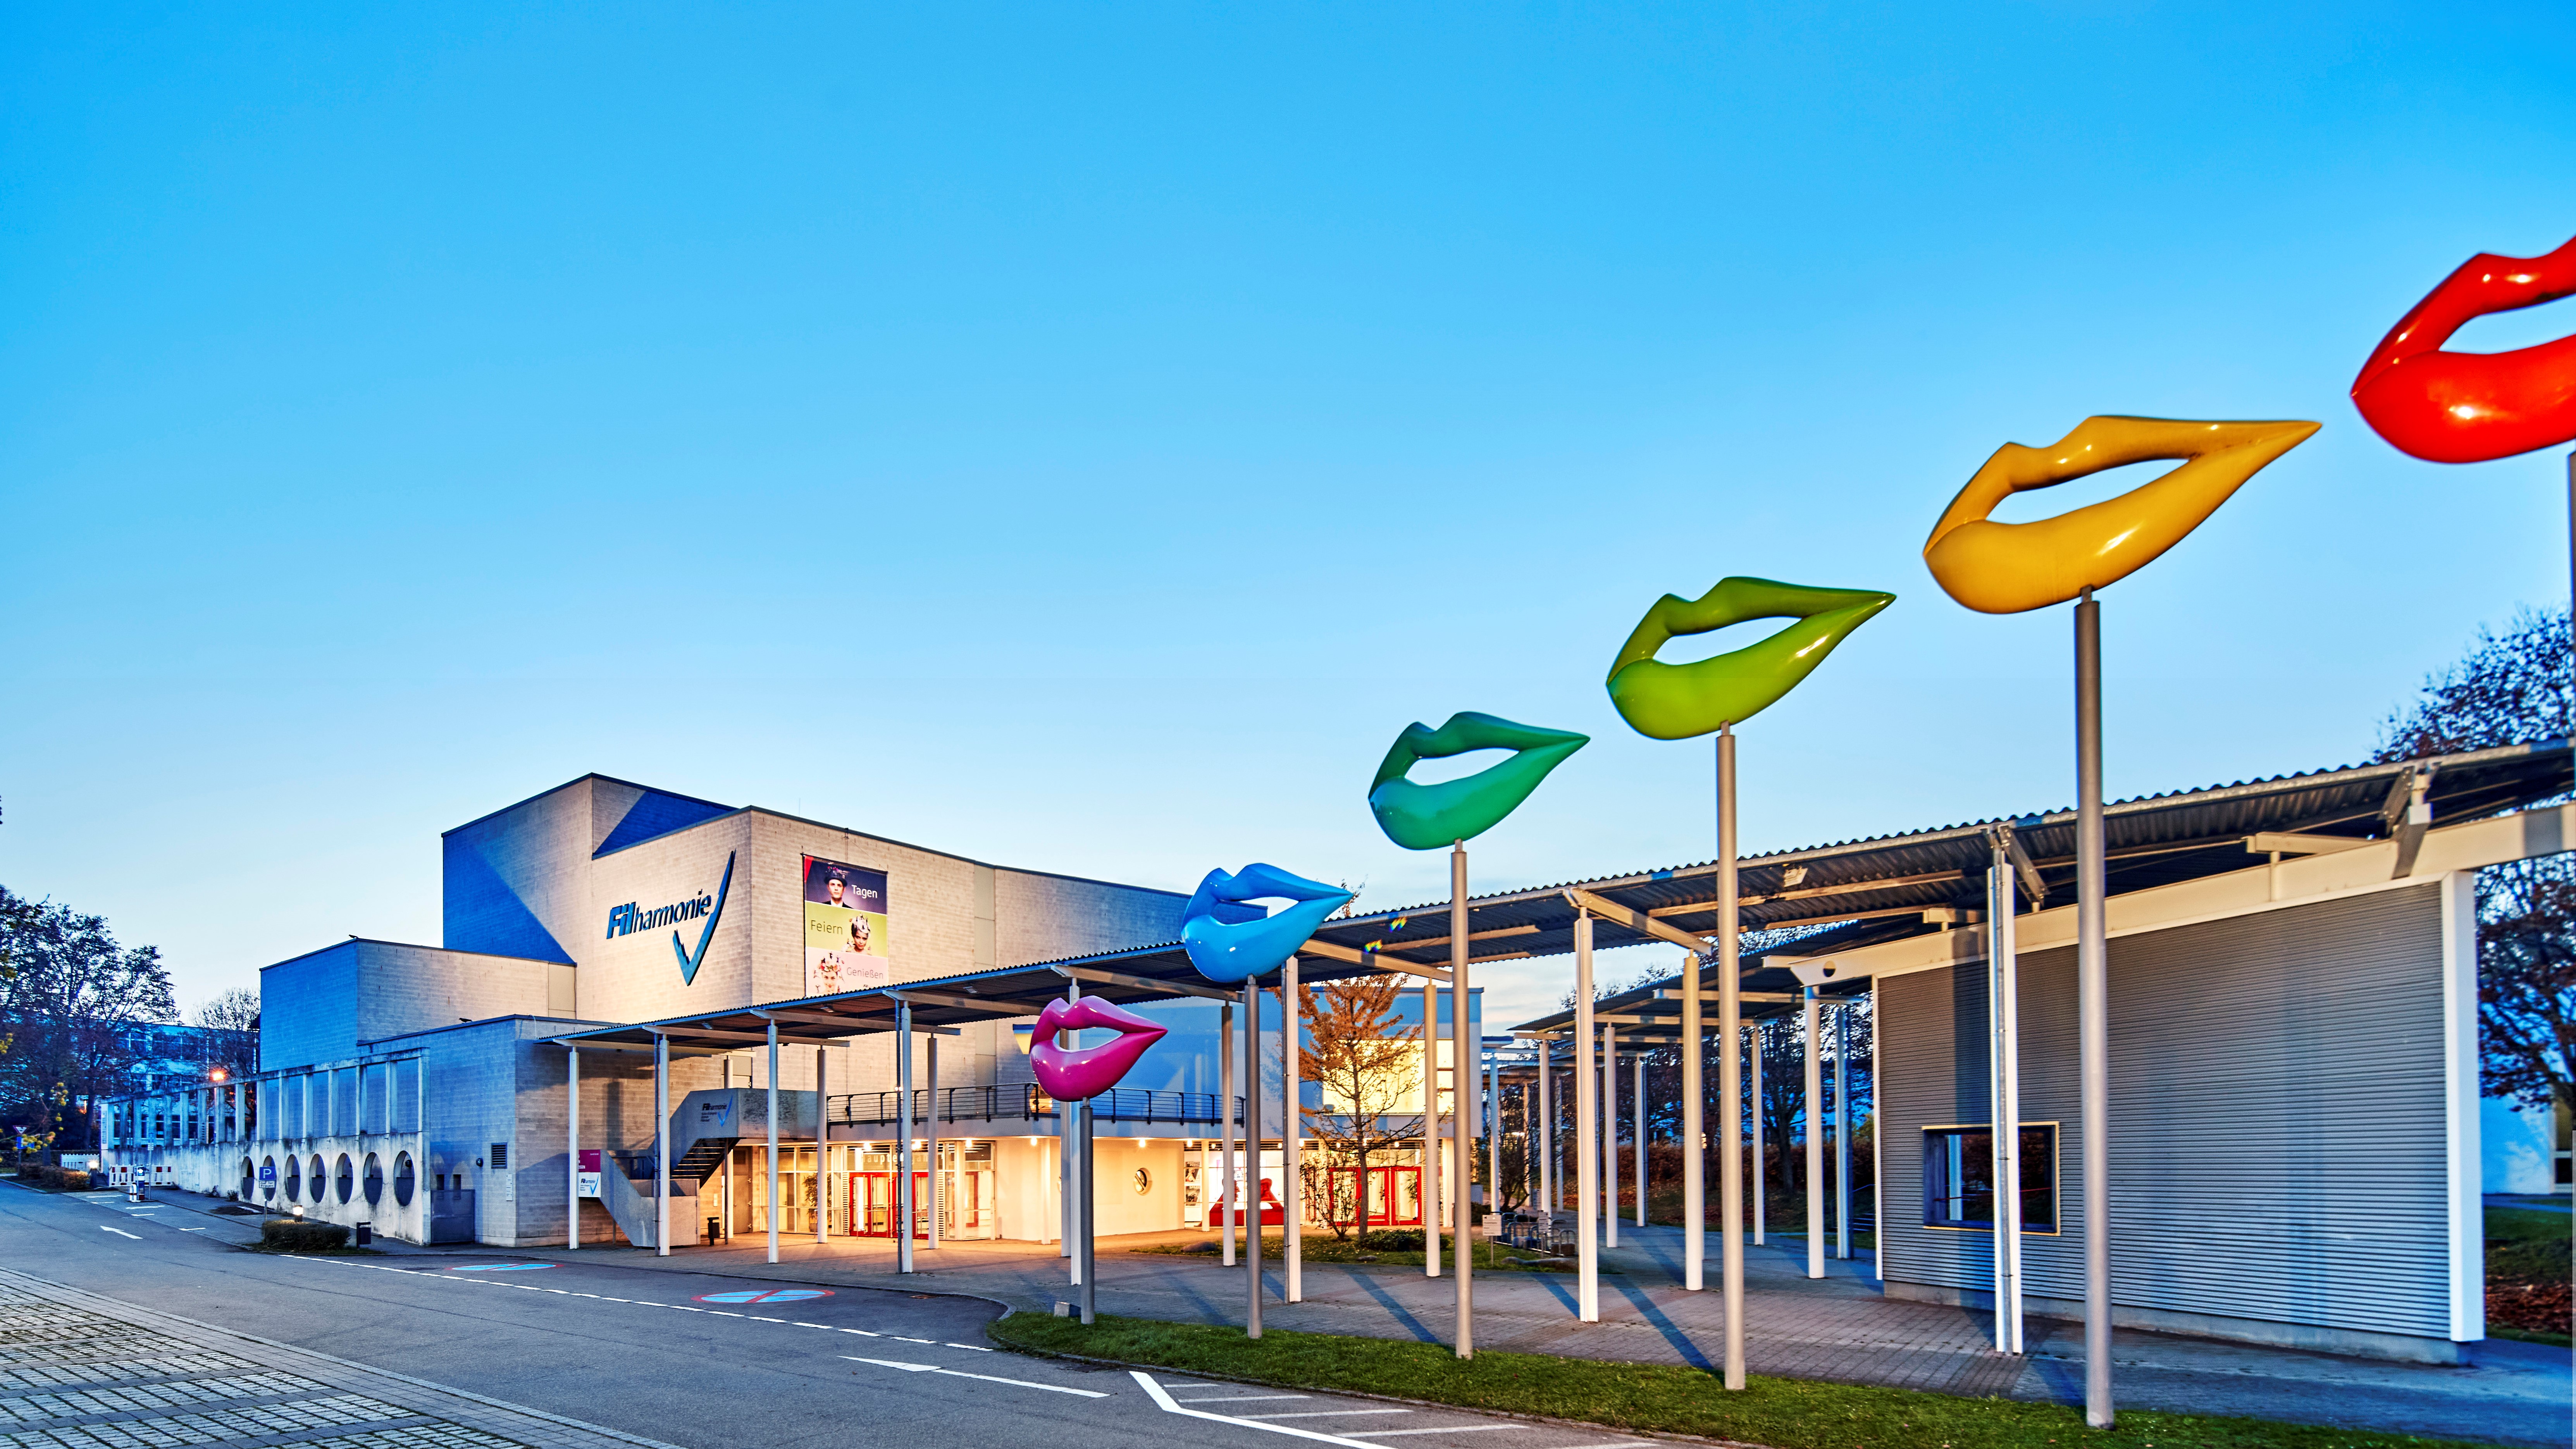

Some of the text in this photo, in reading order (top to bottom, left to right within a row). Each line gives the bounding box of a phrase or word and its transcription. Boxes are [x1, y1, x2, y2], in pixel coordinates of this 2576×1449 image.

[851, 885, 878, 898] Tagen
[606, 889, 711, 939] Filharmonie
[811, 920, 843, 934] Feiern
[847, 967, 883, 979] Genießen
[263, 1168, 272, 1179] P
